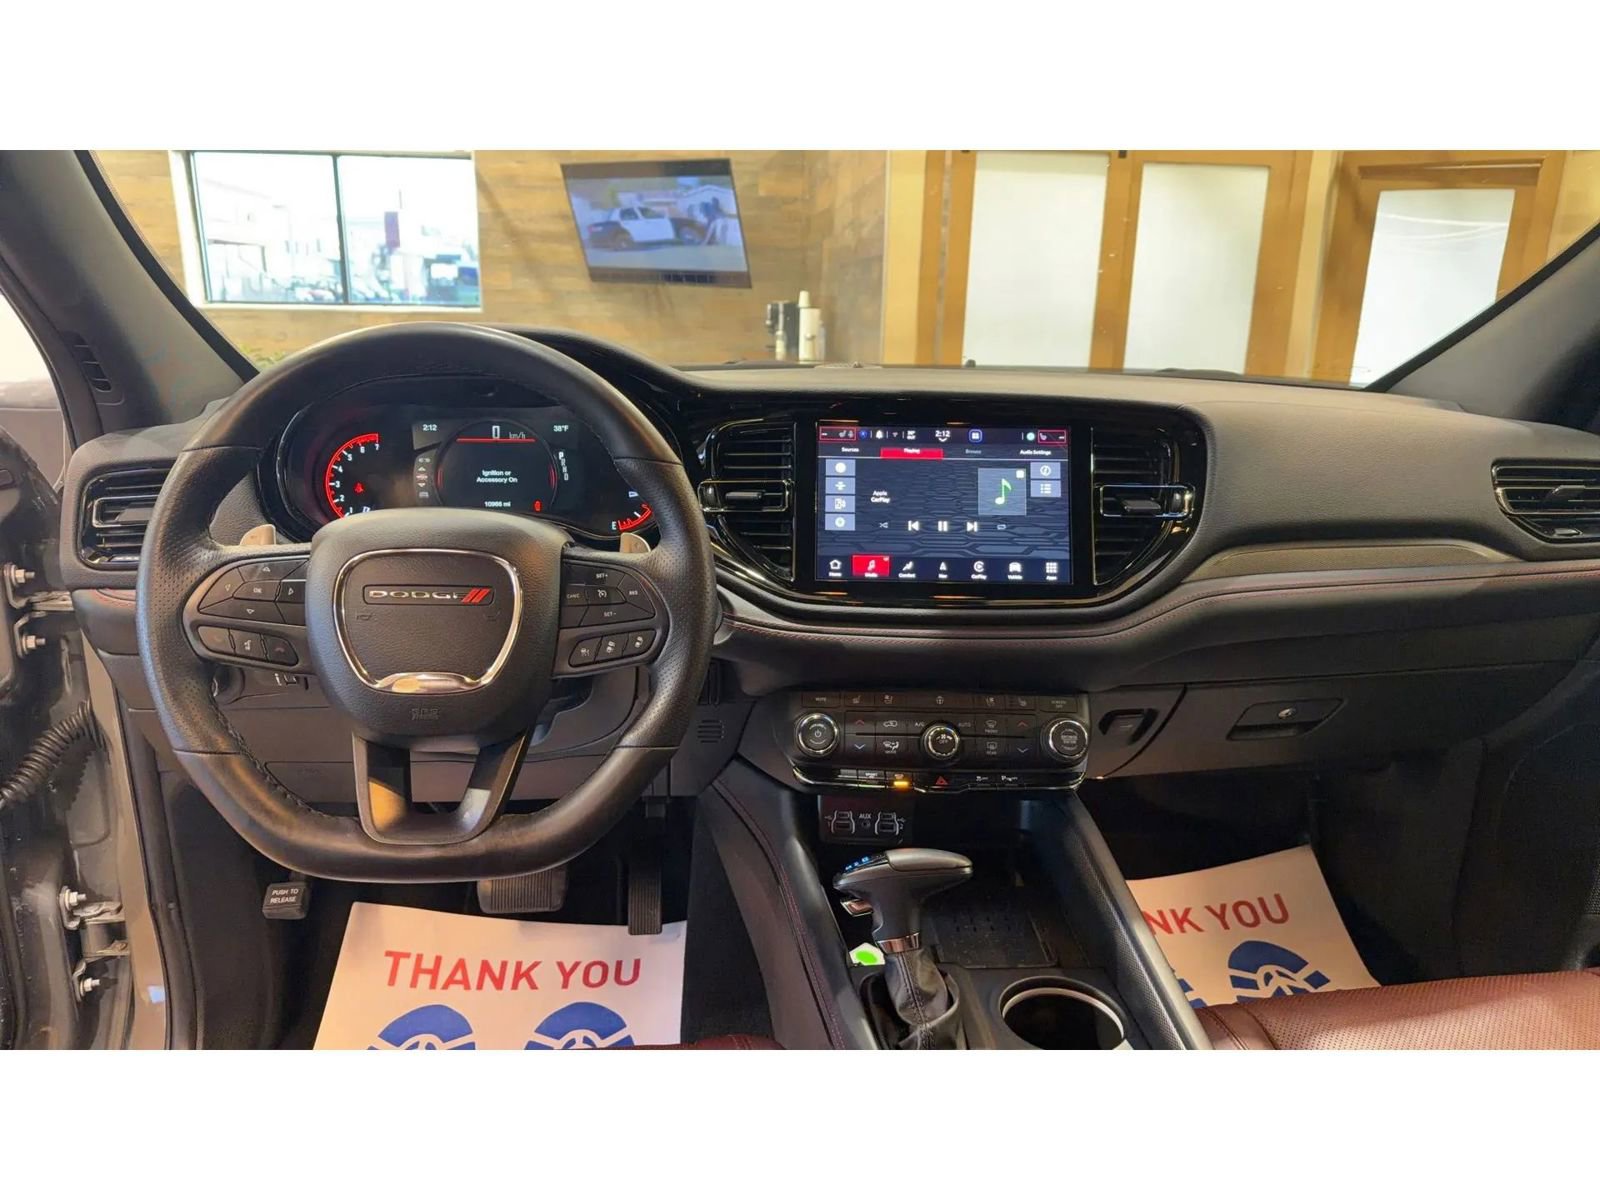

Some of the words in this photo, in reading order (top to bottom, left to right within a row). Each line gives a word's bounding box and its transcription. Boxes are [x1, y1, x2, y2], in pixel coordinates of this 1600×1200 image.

[422, 424, 438, 432] 2:12
[482, 469, 503, 477] Ignition
[612, 521, 616, 530] E
[270, 896, 297, 904] RELEASE
[1204, 893, 1290, 931] YOU
[383, 950, 542, 991] THANK
[556, 958, 641, 989] YOU
